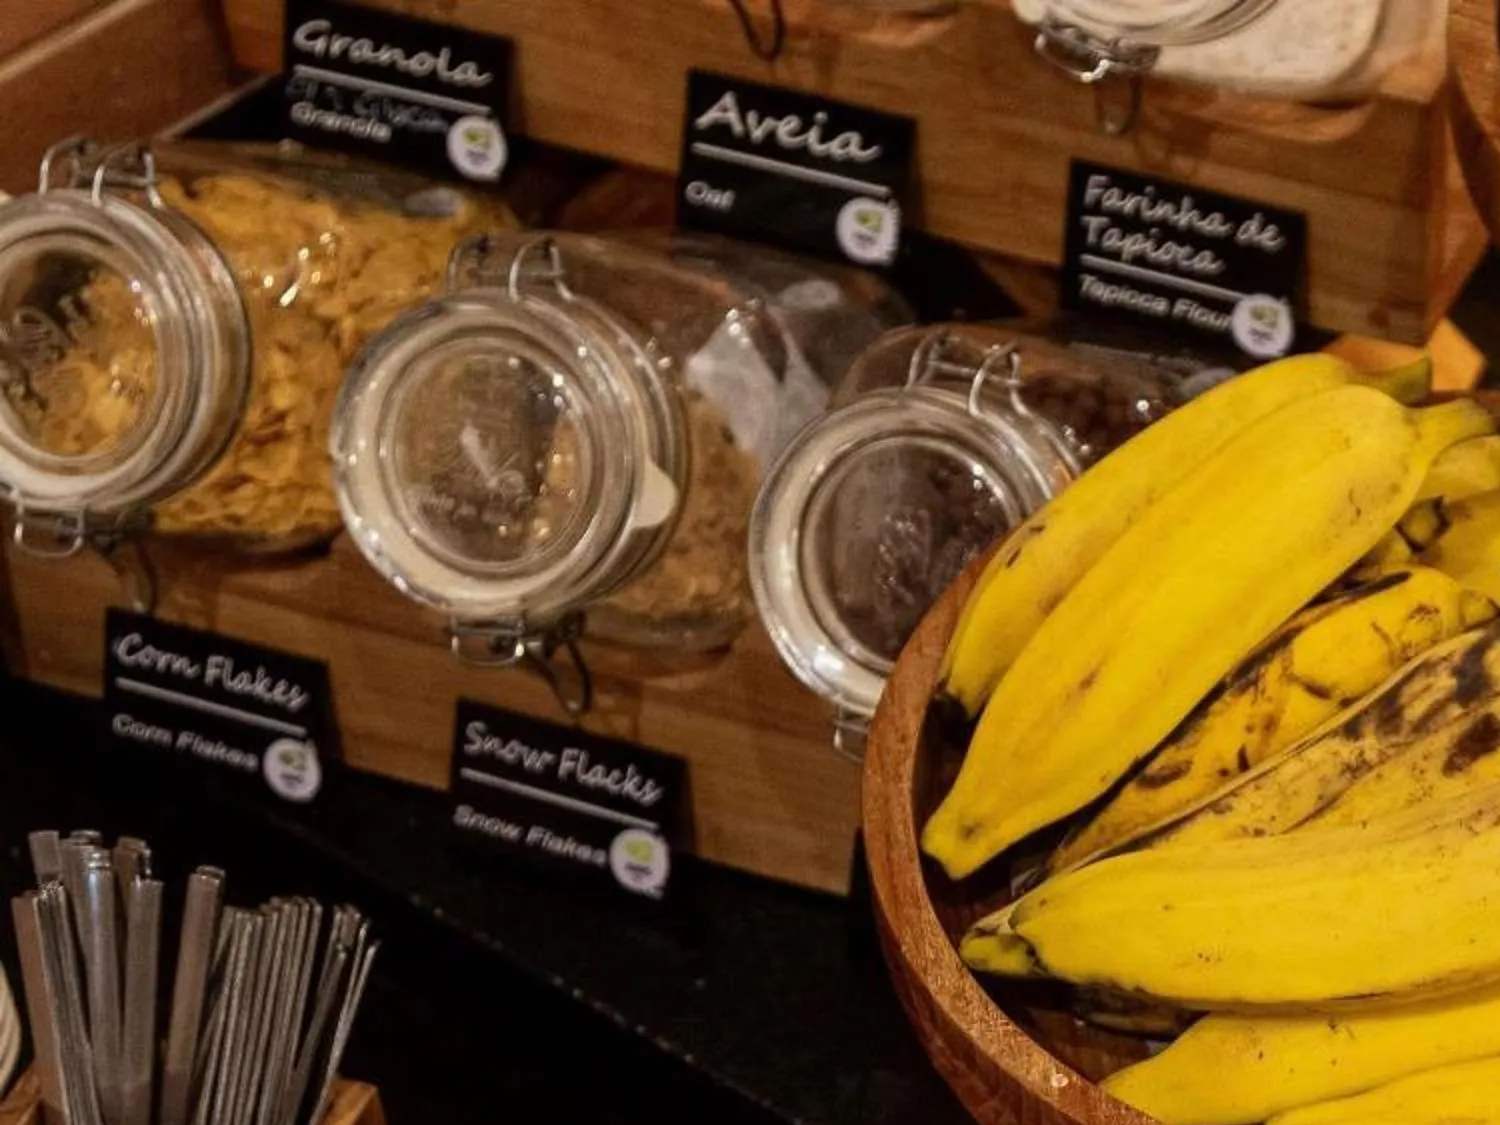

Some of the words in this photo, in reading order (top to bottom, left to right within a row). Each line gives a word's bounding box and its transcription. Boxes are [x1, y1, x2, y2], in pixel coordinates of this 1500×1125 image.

[293, 18, 494, 88] Granola
[694, 90, 882, 162] Aveia
[1080, 215, 1226, 275] Tapioca
[1083, 175, 1234, 237] Farinha
[1235, 211, 1287, 251] de
[1079, 273, 1171, 317] Tapioca
[1171, 299, 1232, 331] Flour
[113, 632, 201, 679] Corn
[204, 654, 310, 713] Flakes
[111, 713, 174, 747] Corn
[463, 720, 557, 773] Snow
[558, 747, 664, 807] Flacks
[452, 804, 524, 843] Snow
[525, 824, 608, 867] Flakes
